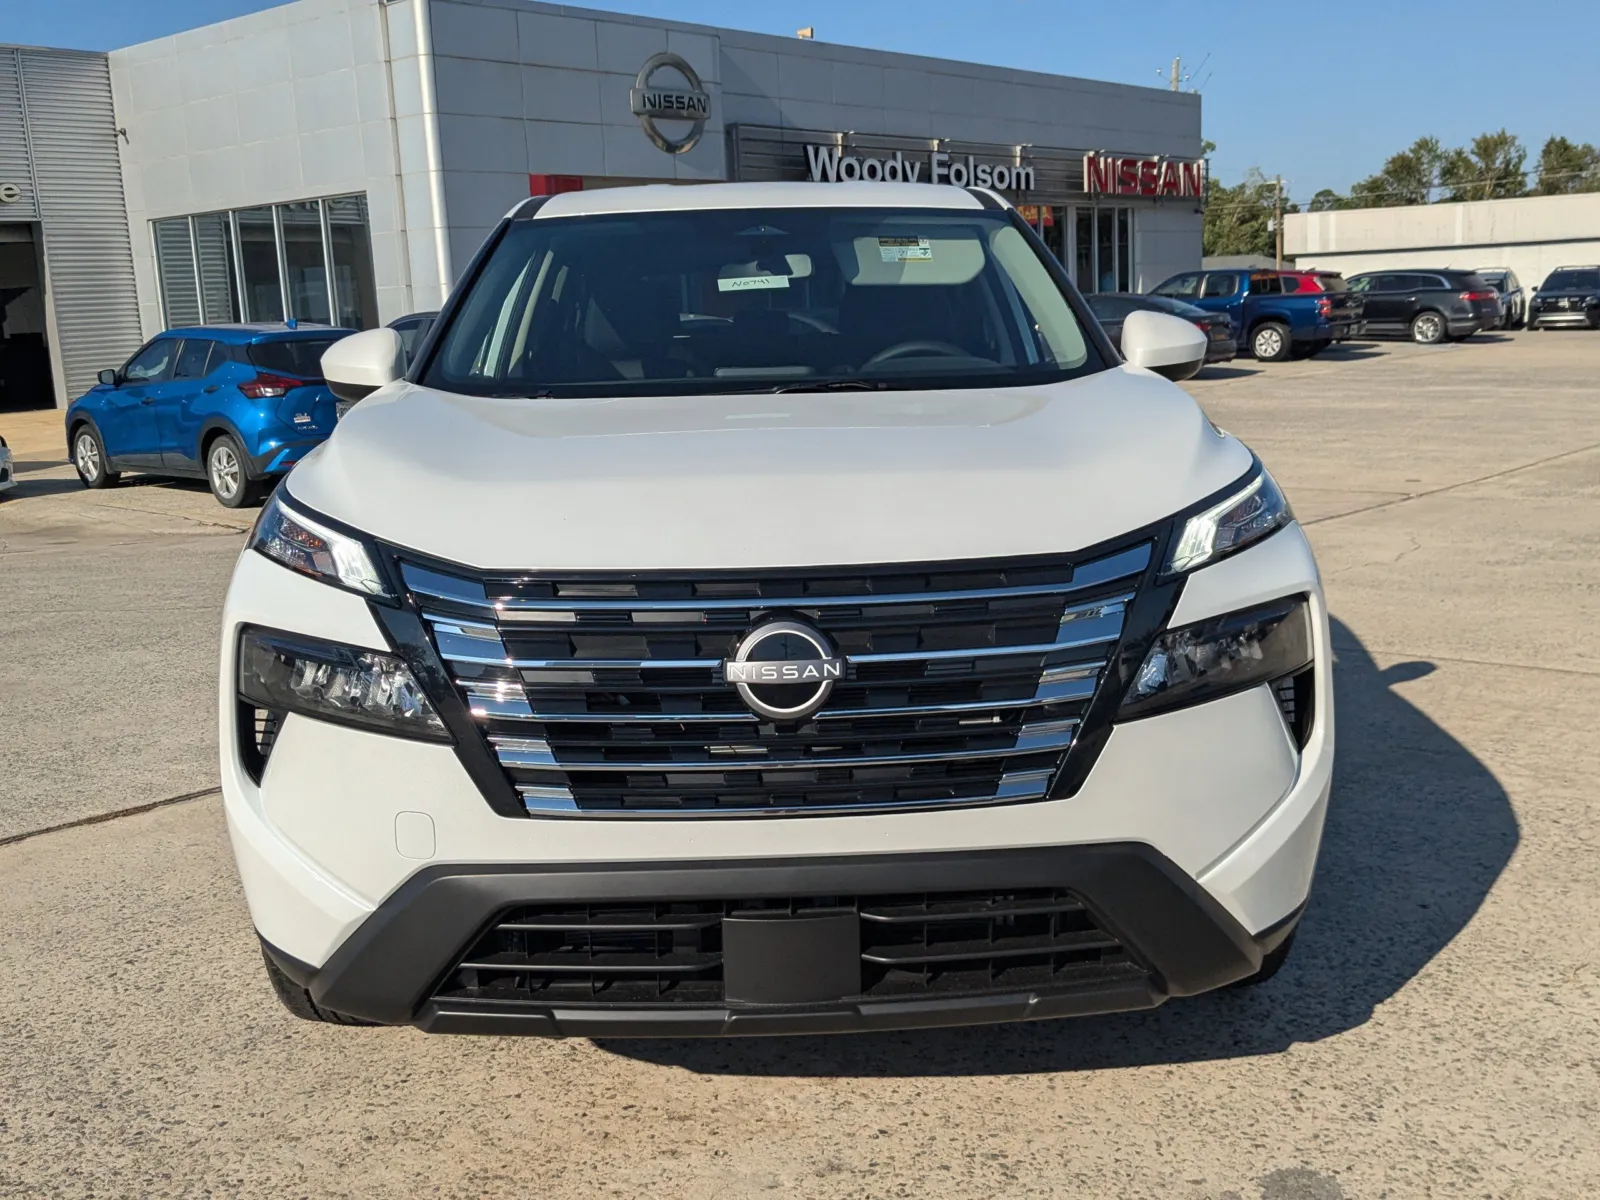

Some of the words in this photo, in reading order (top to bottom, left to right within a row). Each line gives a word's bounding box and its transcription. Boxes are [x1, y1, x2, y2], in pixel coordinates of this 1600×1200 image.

[642, 93, 707, 114] NISSAN
[805, 144, 921, 183] Woody
[931, 151, 1035, 191] Folsom
[1083, 155, 1204, 197] NISSAN
[729, 662, 840, 680] NISSAN
